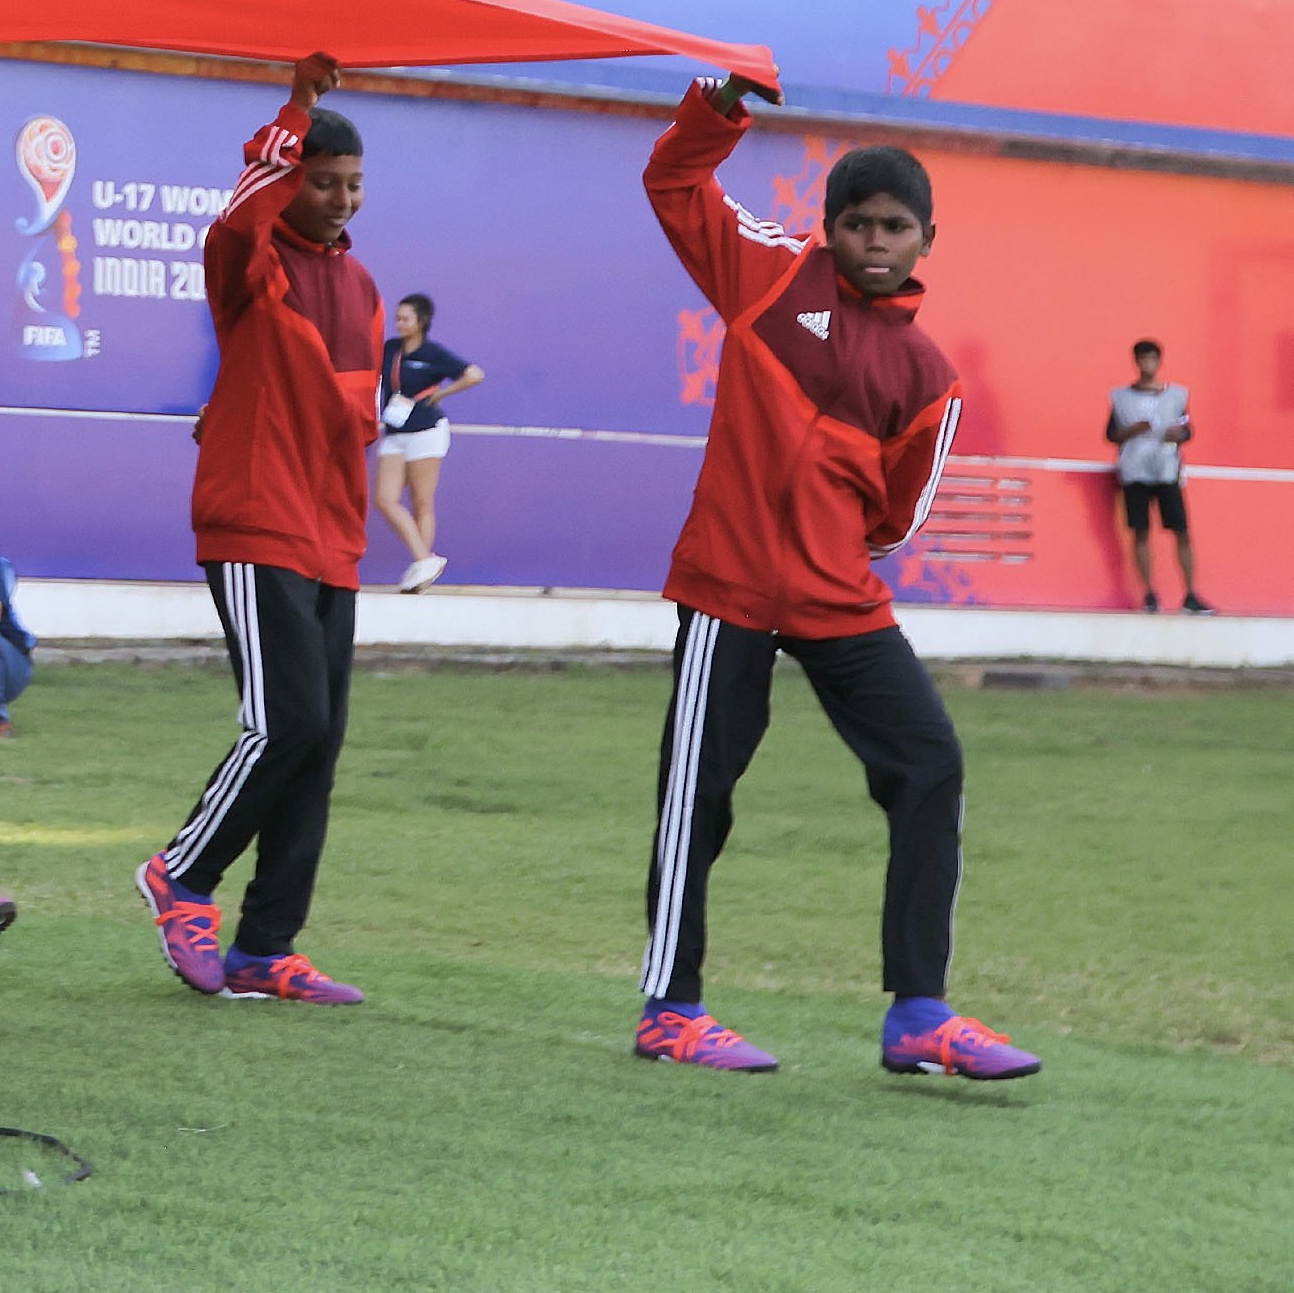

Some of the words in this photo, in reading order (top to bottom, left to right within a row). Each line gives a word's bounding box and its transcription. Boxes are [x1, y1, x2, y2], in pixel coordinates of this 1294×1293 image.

[92, 180, 156, 212] U-17
[160, 185, 234, 217] WOM
[92, 218, 196, 252] WORLD
[93, 256, 166, 300] INDIA
[169, 260, 206, 301] 20
[22, 325, 68, 347] FIFA
[797, 313, 830, 341] adidas
